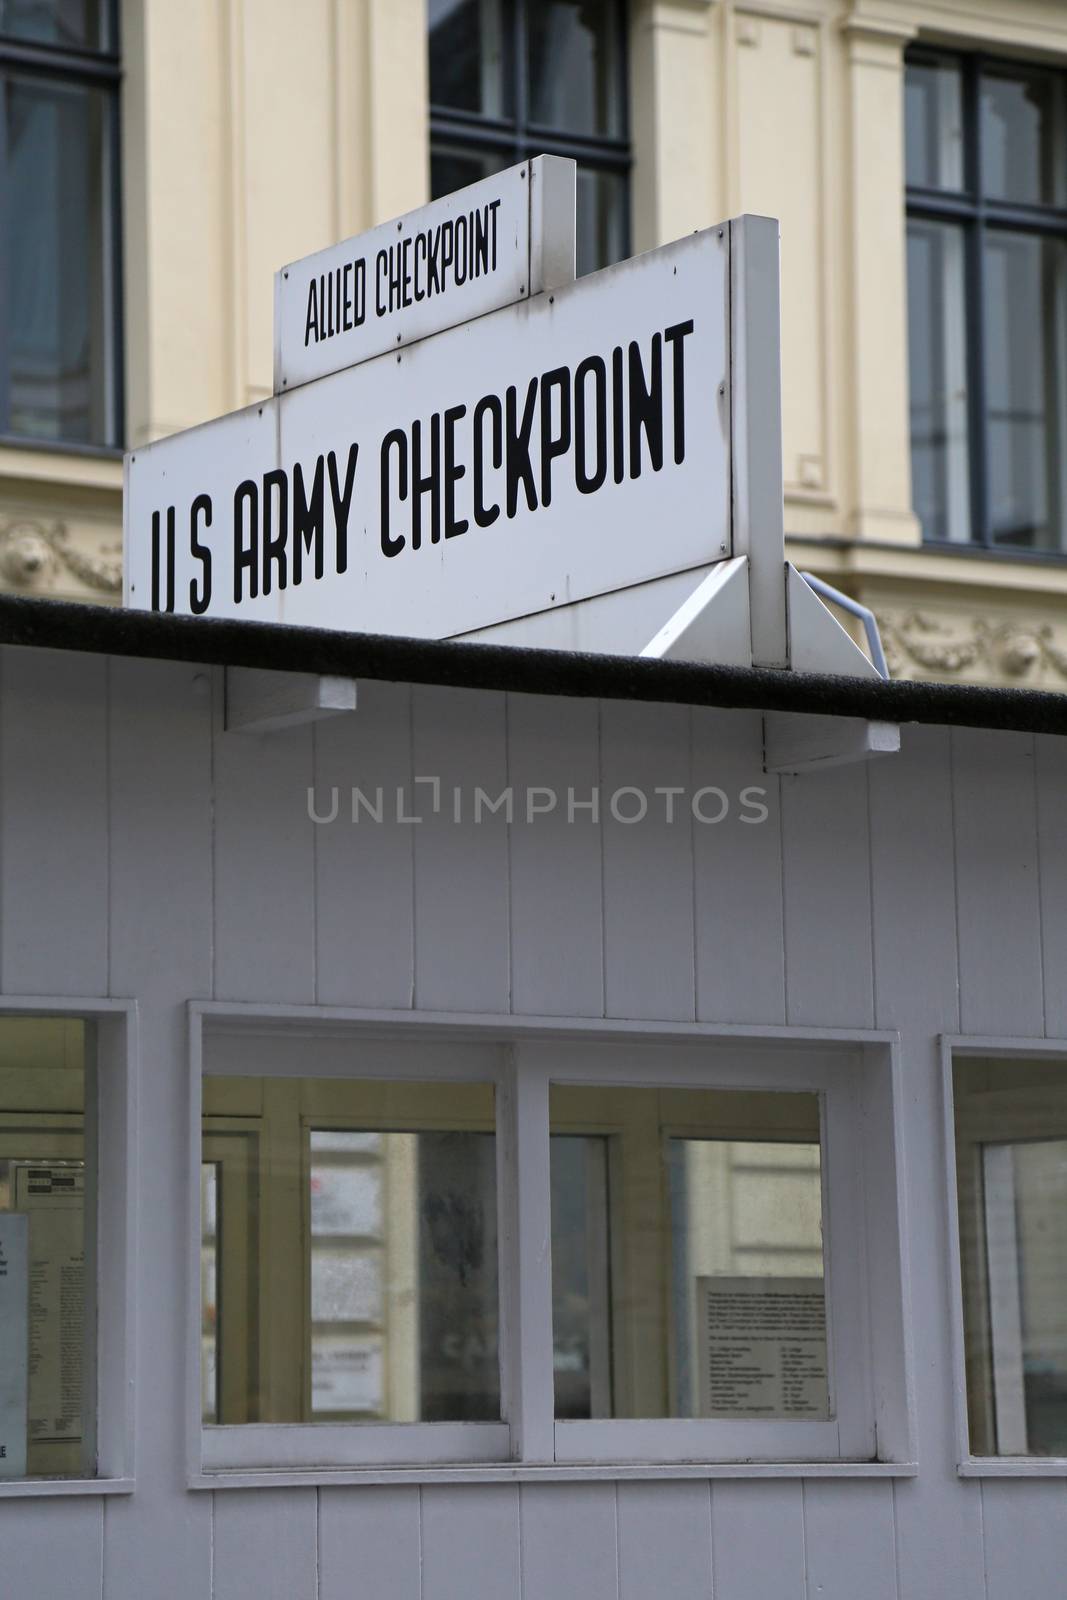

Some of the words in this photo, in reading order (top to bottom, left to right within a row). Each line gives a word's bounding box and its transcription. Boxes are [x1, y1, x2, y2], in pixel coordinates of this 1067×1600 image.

[304, 257, 366, 347] ALLIED
[375, 198, 501, 318] CHECKPOINT
[233, 442, 359, 604] ARMY
[380, 319, 694, 558] CHECKPOINT
